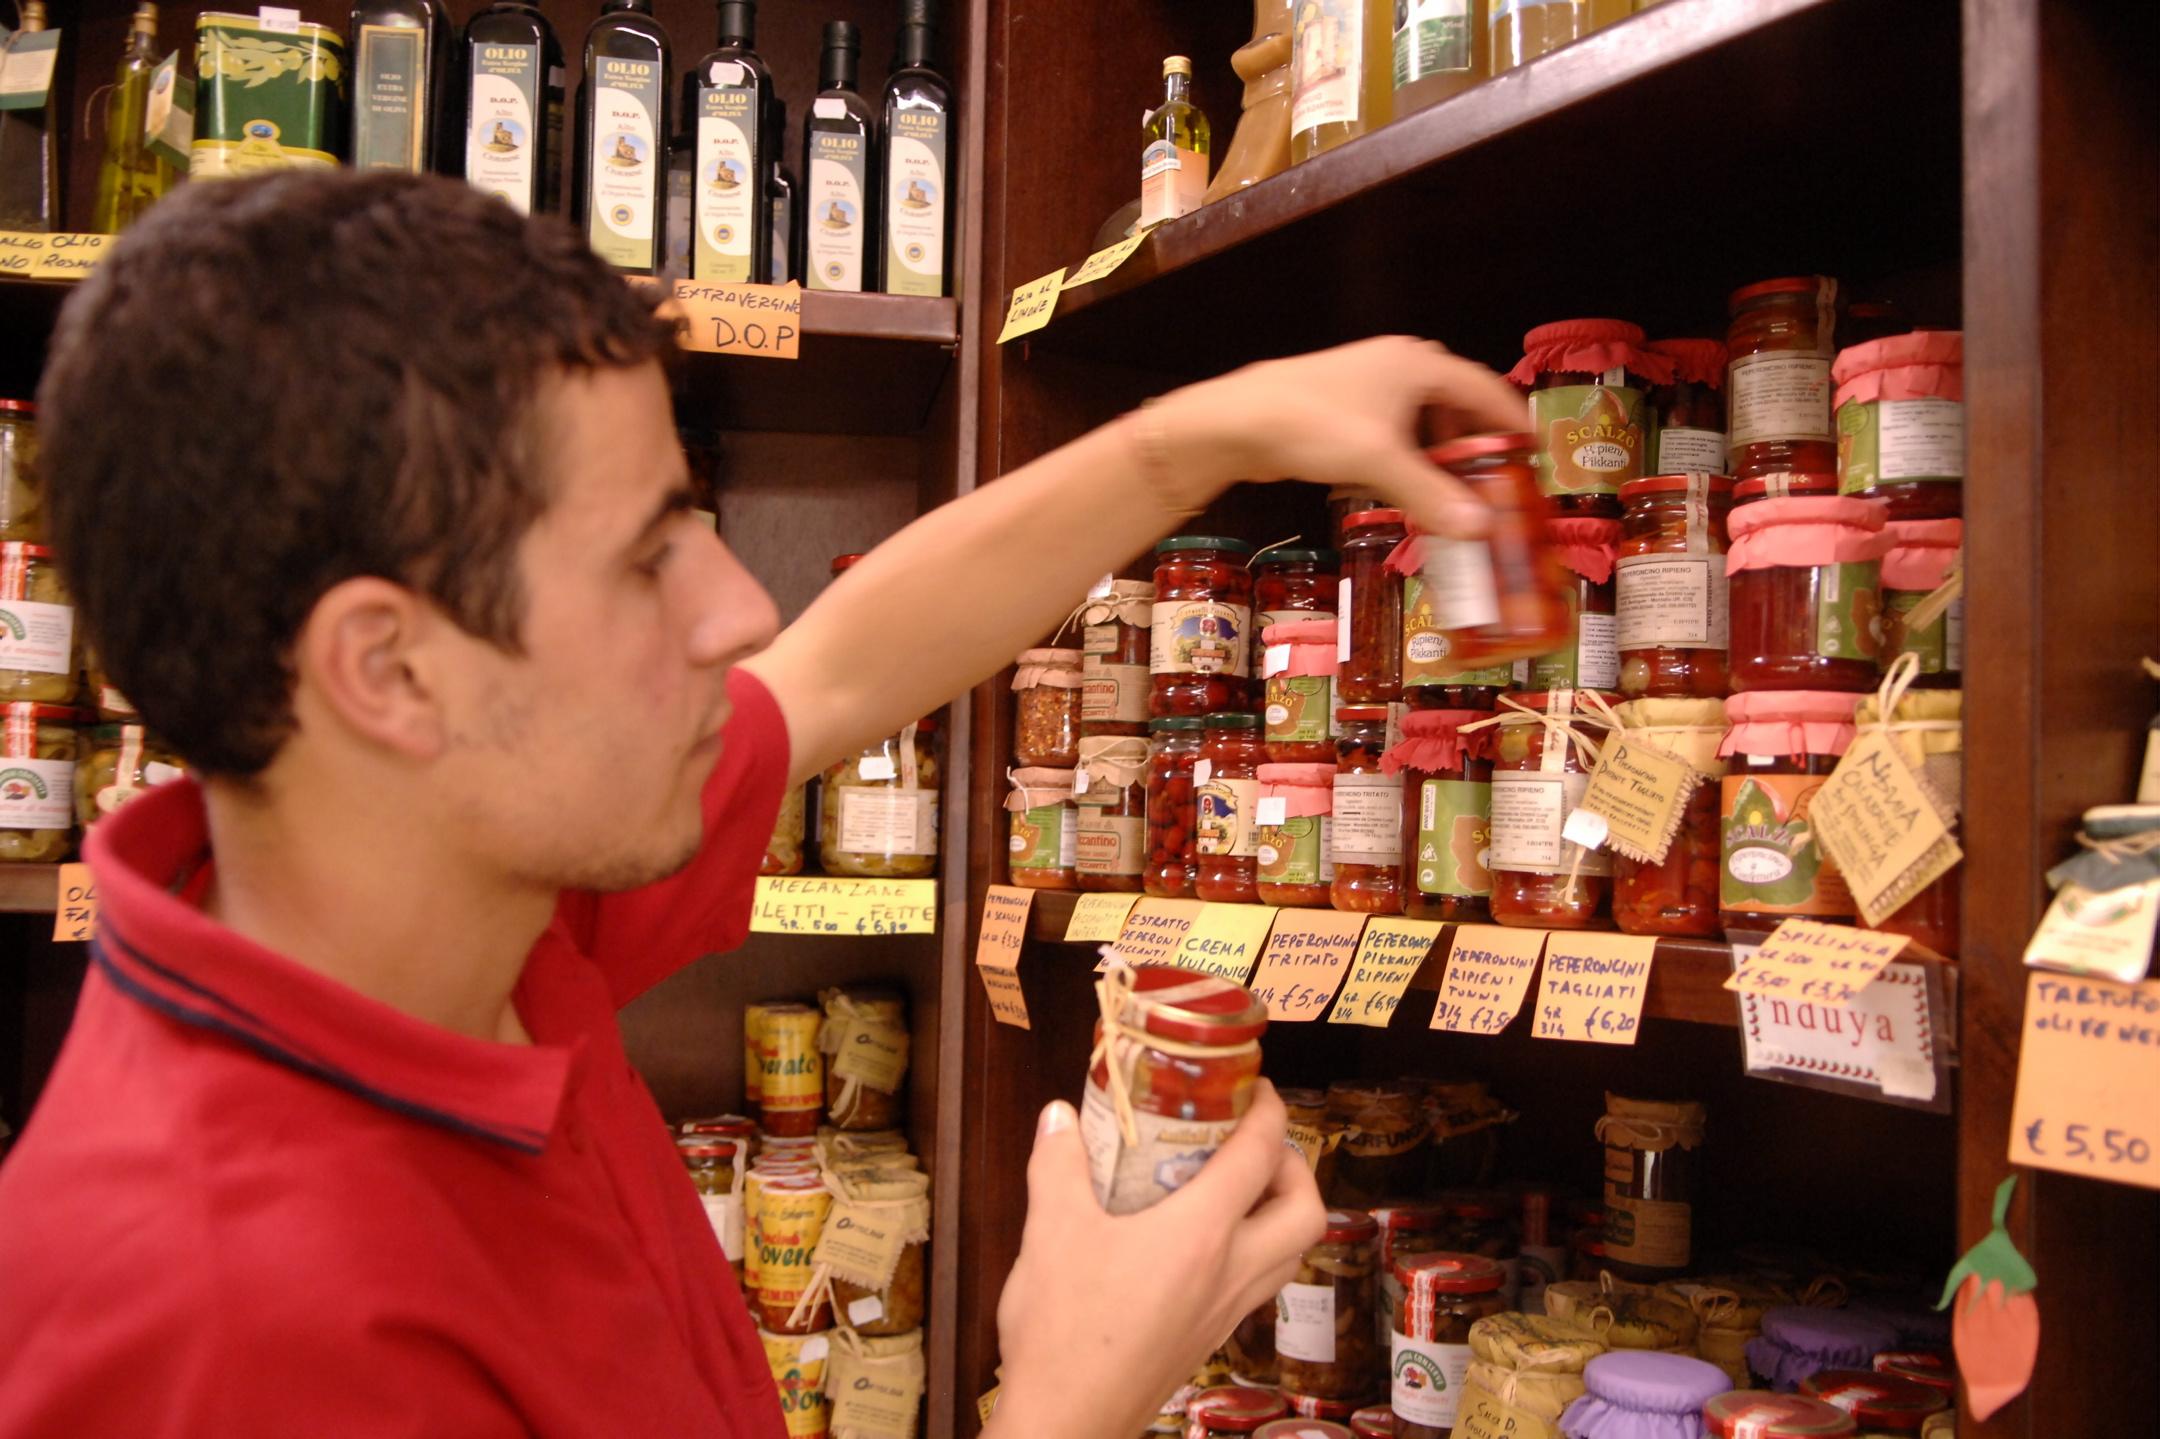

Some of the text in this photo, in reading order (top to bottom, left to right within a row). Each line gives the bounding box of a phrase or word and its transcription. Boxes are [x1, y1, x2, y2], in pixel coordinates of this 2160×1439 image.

[485, 48, 527, 60] OLIO
[607, 61, 650, 75] OLIO
[708, 93, 747, 104] OLIO
[900, 114, 937, 126] OLIO
[821, 137, 857, 149] OLIO
[51, 234, 101, 249] OLIO
[676, 285, 800, 314] EXTRAVERGINE
[1010, 300, 1048, 323] LIMONE
[1566, 423, 1635, 449] SCALZO
[1581, 456, 1626, 469] Pikkanti
[1412, 632, 1443, 647] Ripieni
[1410, 646, 1447, 659] Pikkanti
[769, 879, 910, 897] MELANZANE
[754, 900, 825, 919] ILETTI
[870, 903, 935, 921] FETTE
[1128, 914, 1190, 932] ESTRATTO
[1121, 929, 1182, 948] PEPERONI
[1185, 936, 1246, 957] CREMA
[1271, 932, 1357, 949] PEPERONCINO
[1778, 928, 1890, 957] SPILINGA
[1114, 943, 1166, 958] PICCANTI
[1362, 951, 1424, 967] PIKKANTI
[1452, 947, 1534, 969] PEPERONCINI
[1268, 953, 1339, 967] TRITATO
[1548, 954, 1646, 978] PEPERONCINI
[1354, 968, 1410, 983] RIPIENI
[1449, 967, 1514, 986] RIPIENI
[1548, 980, 1636, 999] TAGLIATI
[2036, 982, 2160, 1013] TARTUFO
[1762, 994, 1896, 1048] 'nduya
[2036, 1014, 2110, 1039] OLIVE
[2026, 1119, 2151, 1165] € 5,50
